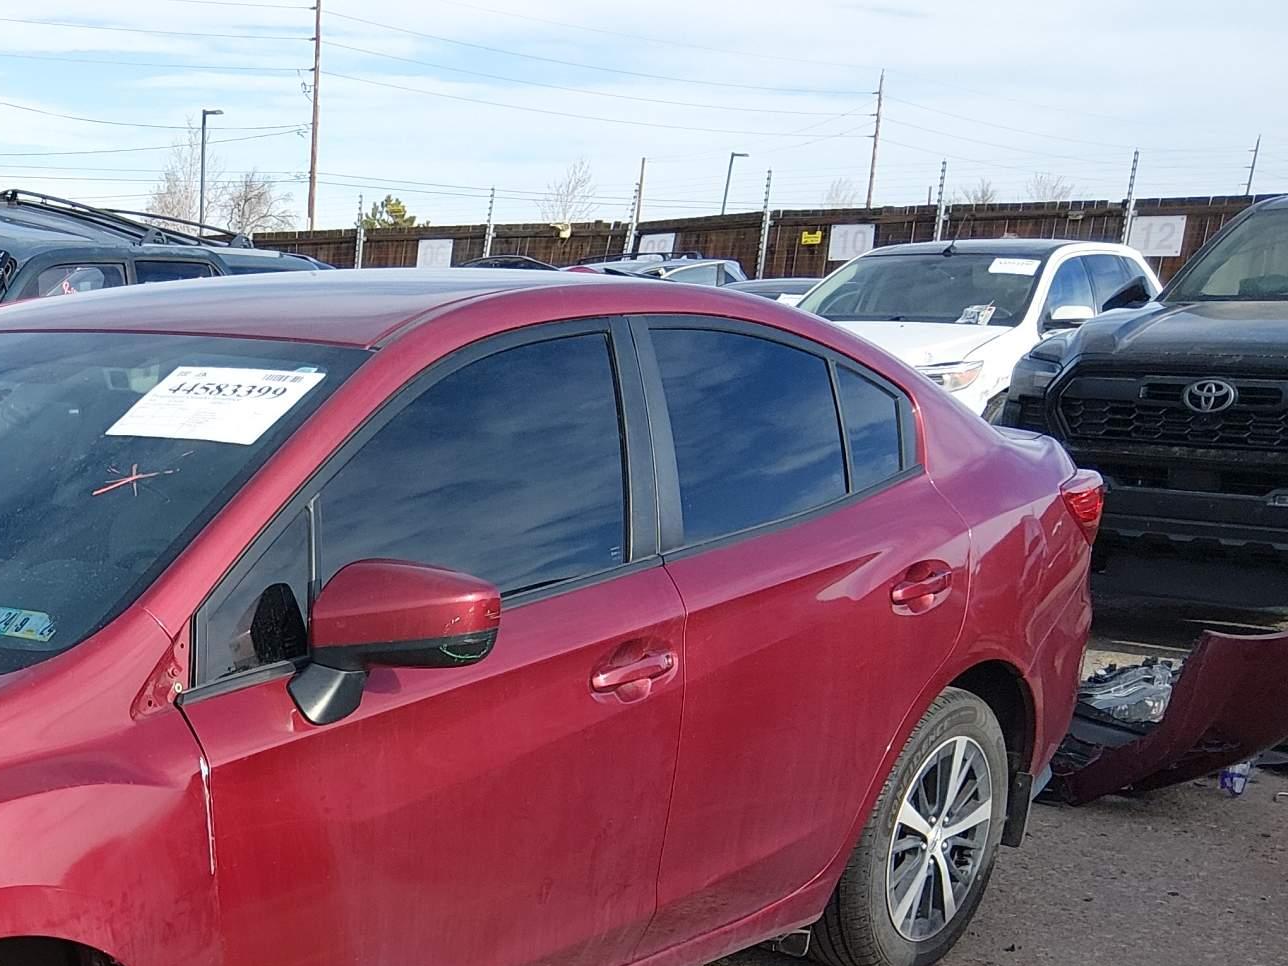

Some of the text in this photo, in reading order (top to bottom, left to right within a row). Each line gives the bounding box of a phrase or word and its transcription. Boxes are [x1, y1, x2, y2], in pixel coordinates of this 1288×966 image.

[839, 229, 867, 255] 10
[1141, 222, 1175, 250] 12
[168, 382, 288, 399] 44583399
